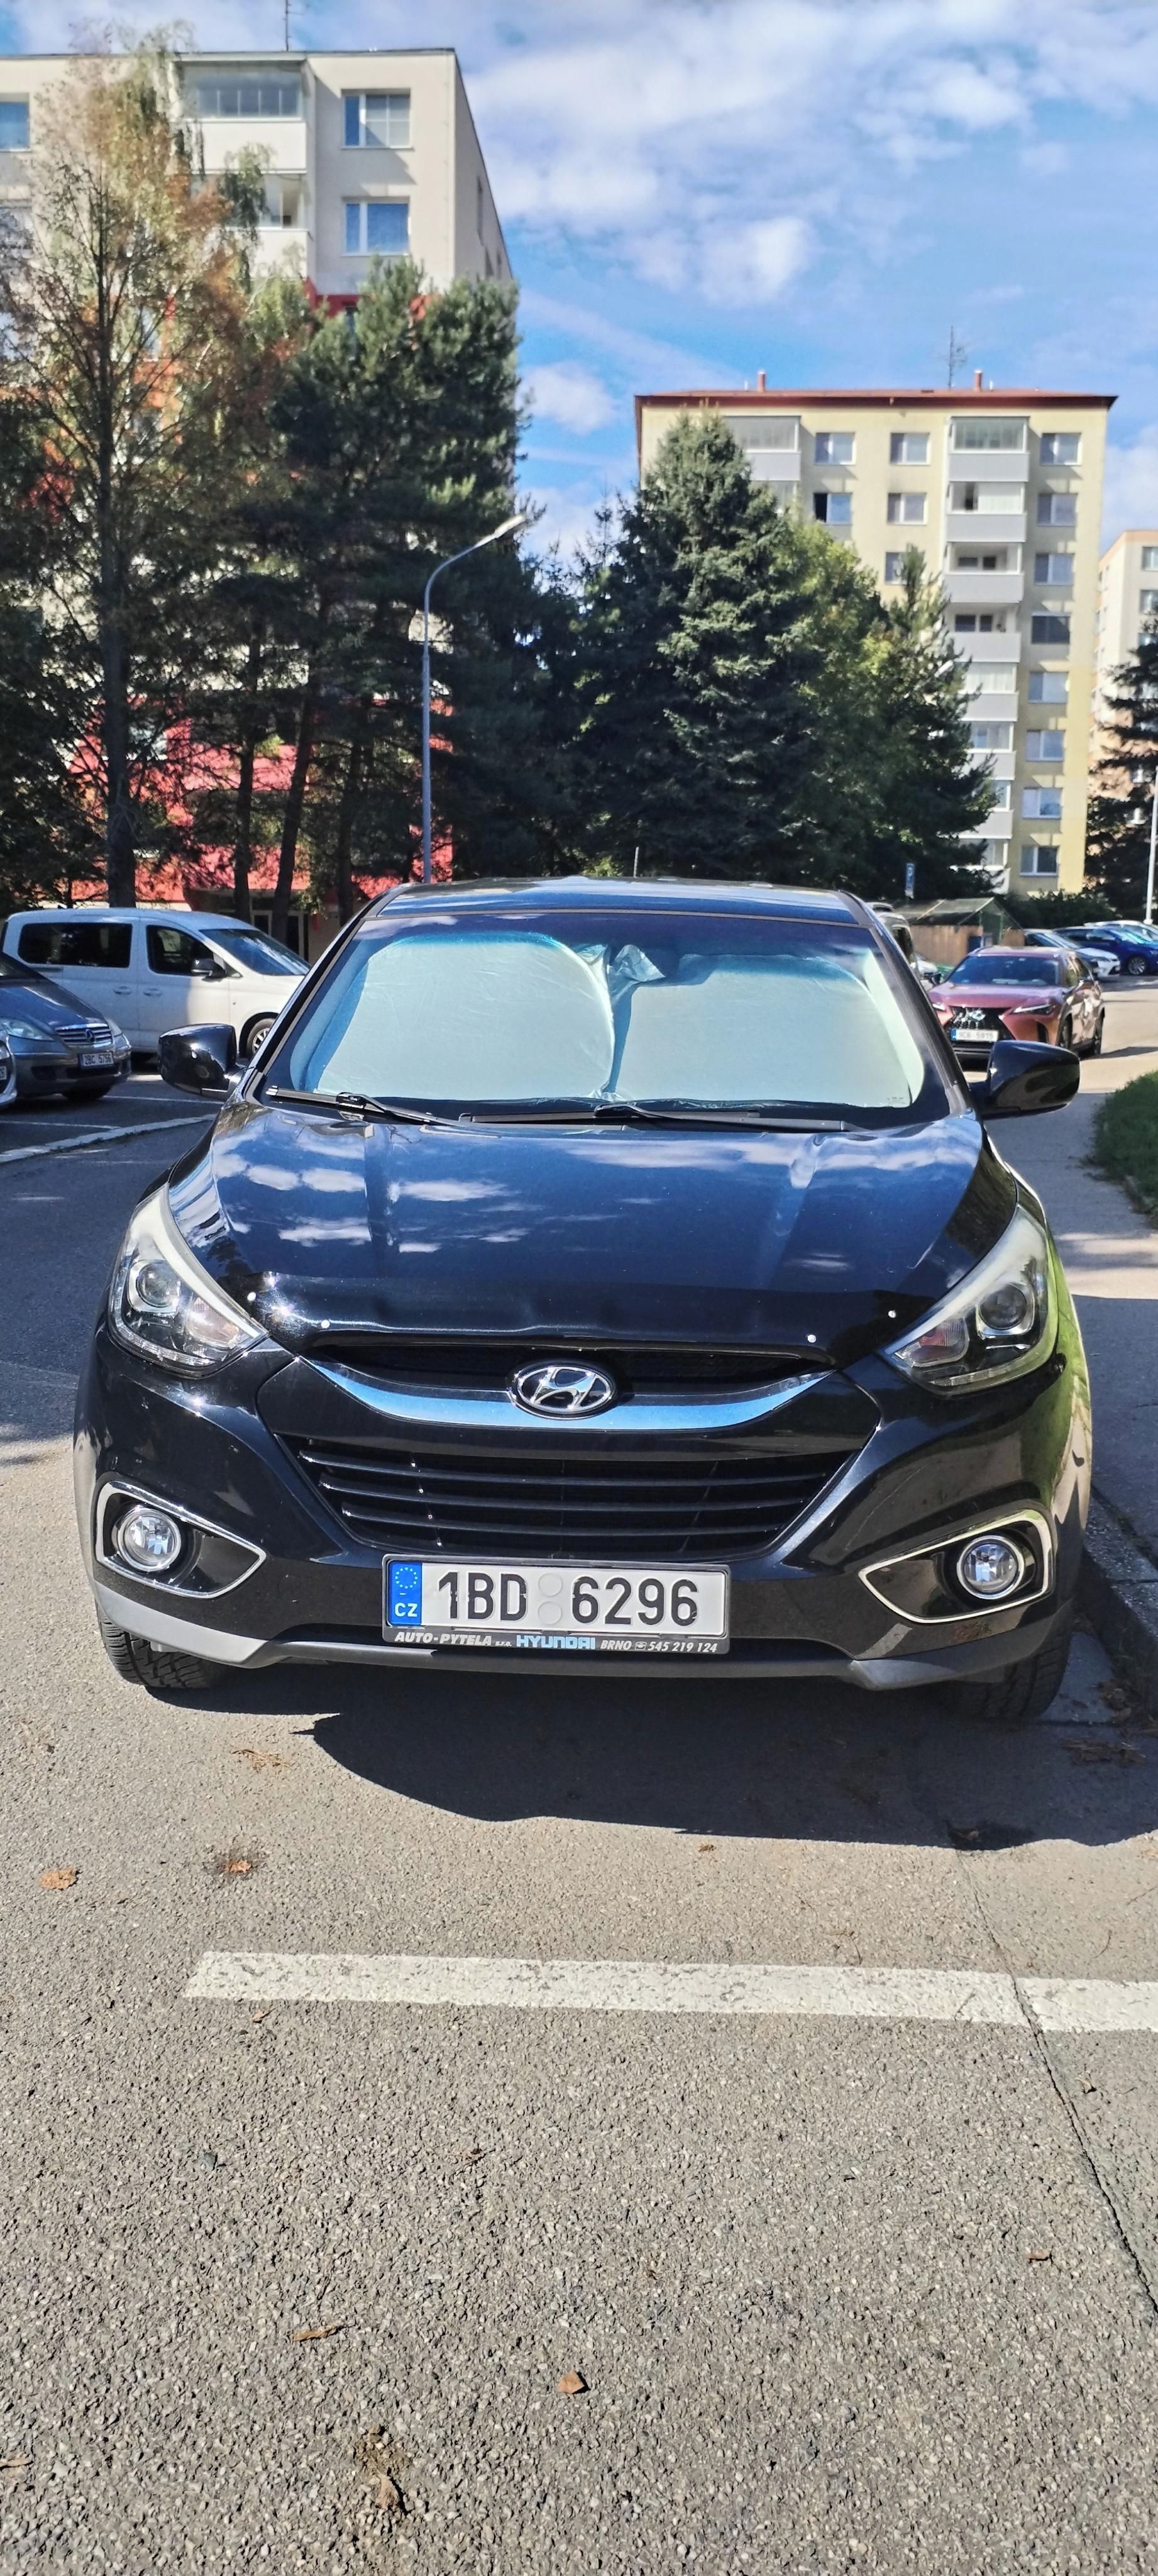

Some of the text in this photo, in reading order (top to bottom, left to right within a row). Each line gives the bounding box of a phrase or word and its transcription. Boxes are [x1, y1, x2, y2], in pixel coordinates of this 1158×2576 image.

[439, 1572, 698, 1626] 1BD 6296
[395, 1602, 418, 1618] CZ
[516, 1635, 596, 1650] HYUNDAI
[600, 1640, 632, 1651] BRNO
[647, 1641, 670, 1652] 545
[671, 1642, 694, 1653] 219
[697, 1643, 718, 1653] 124
